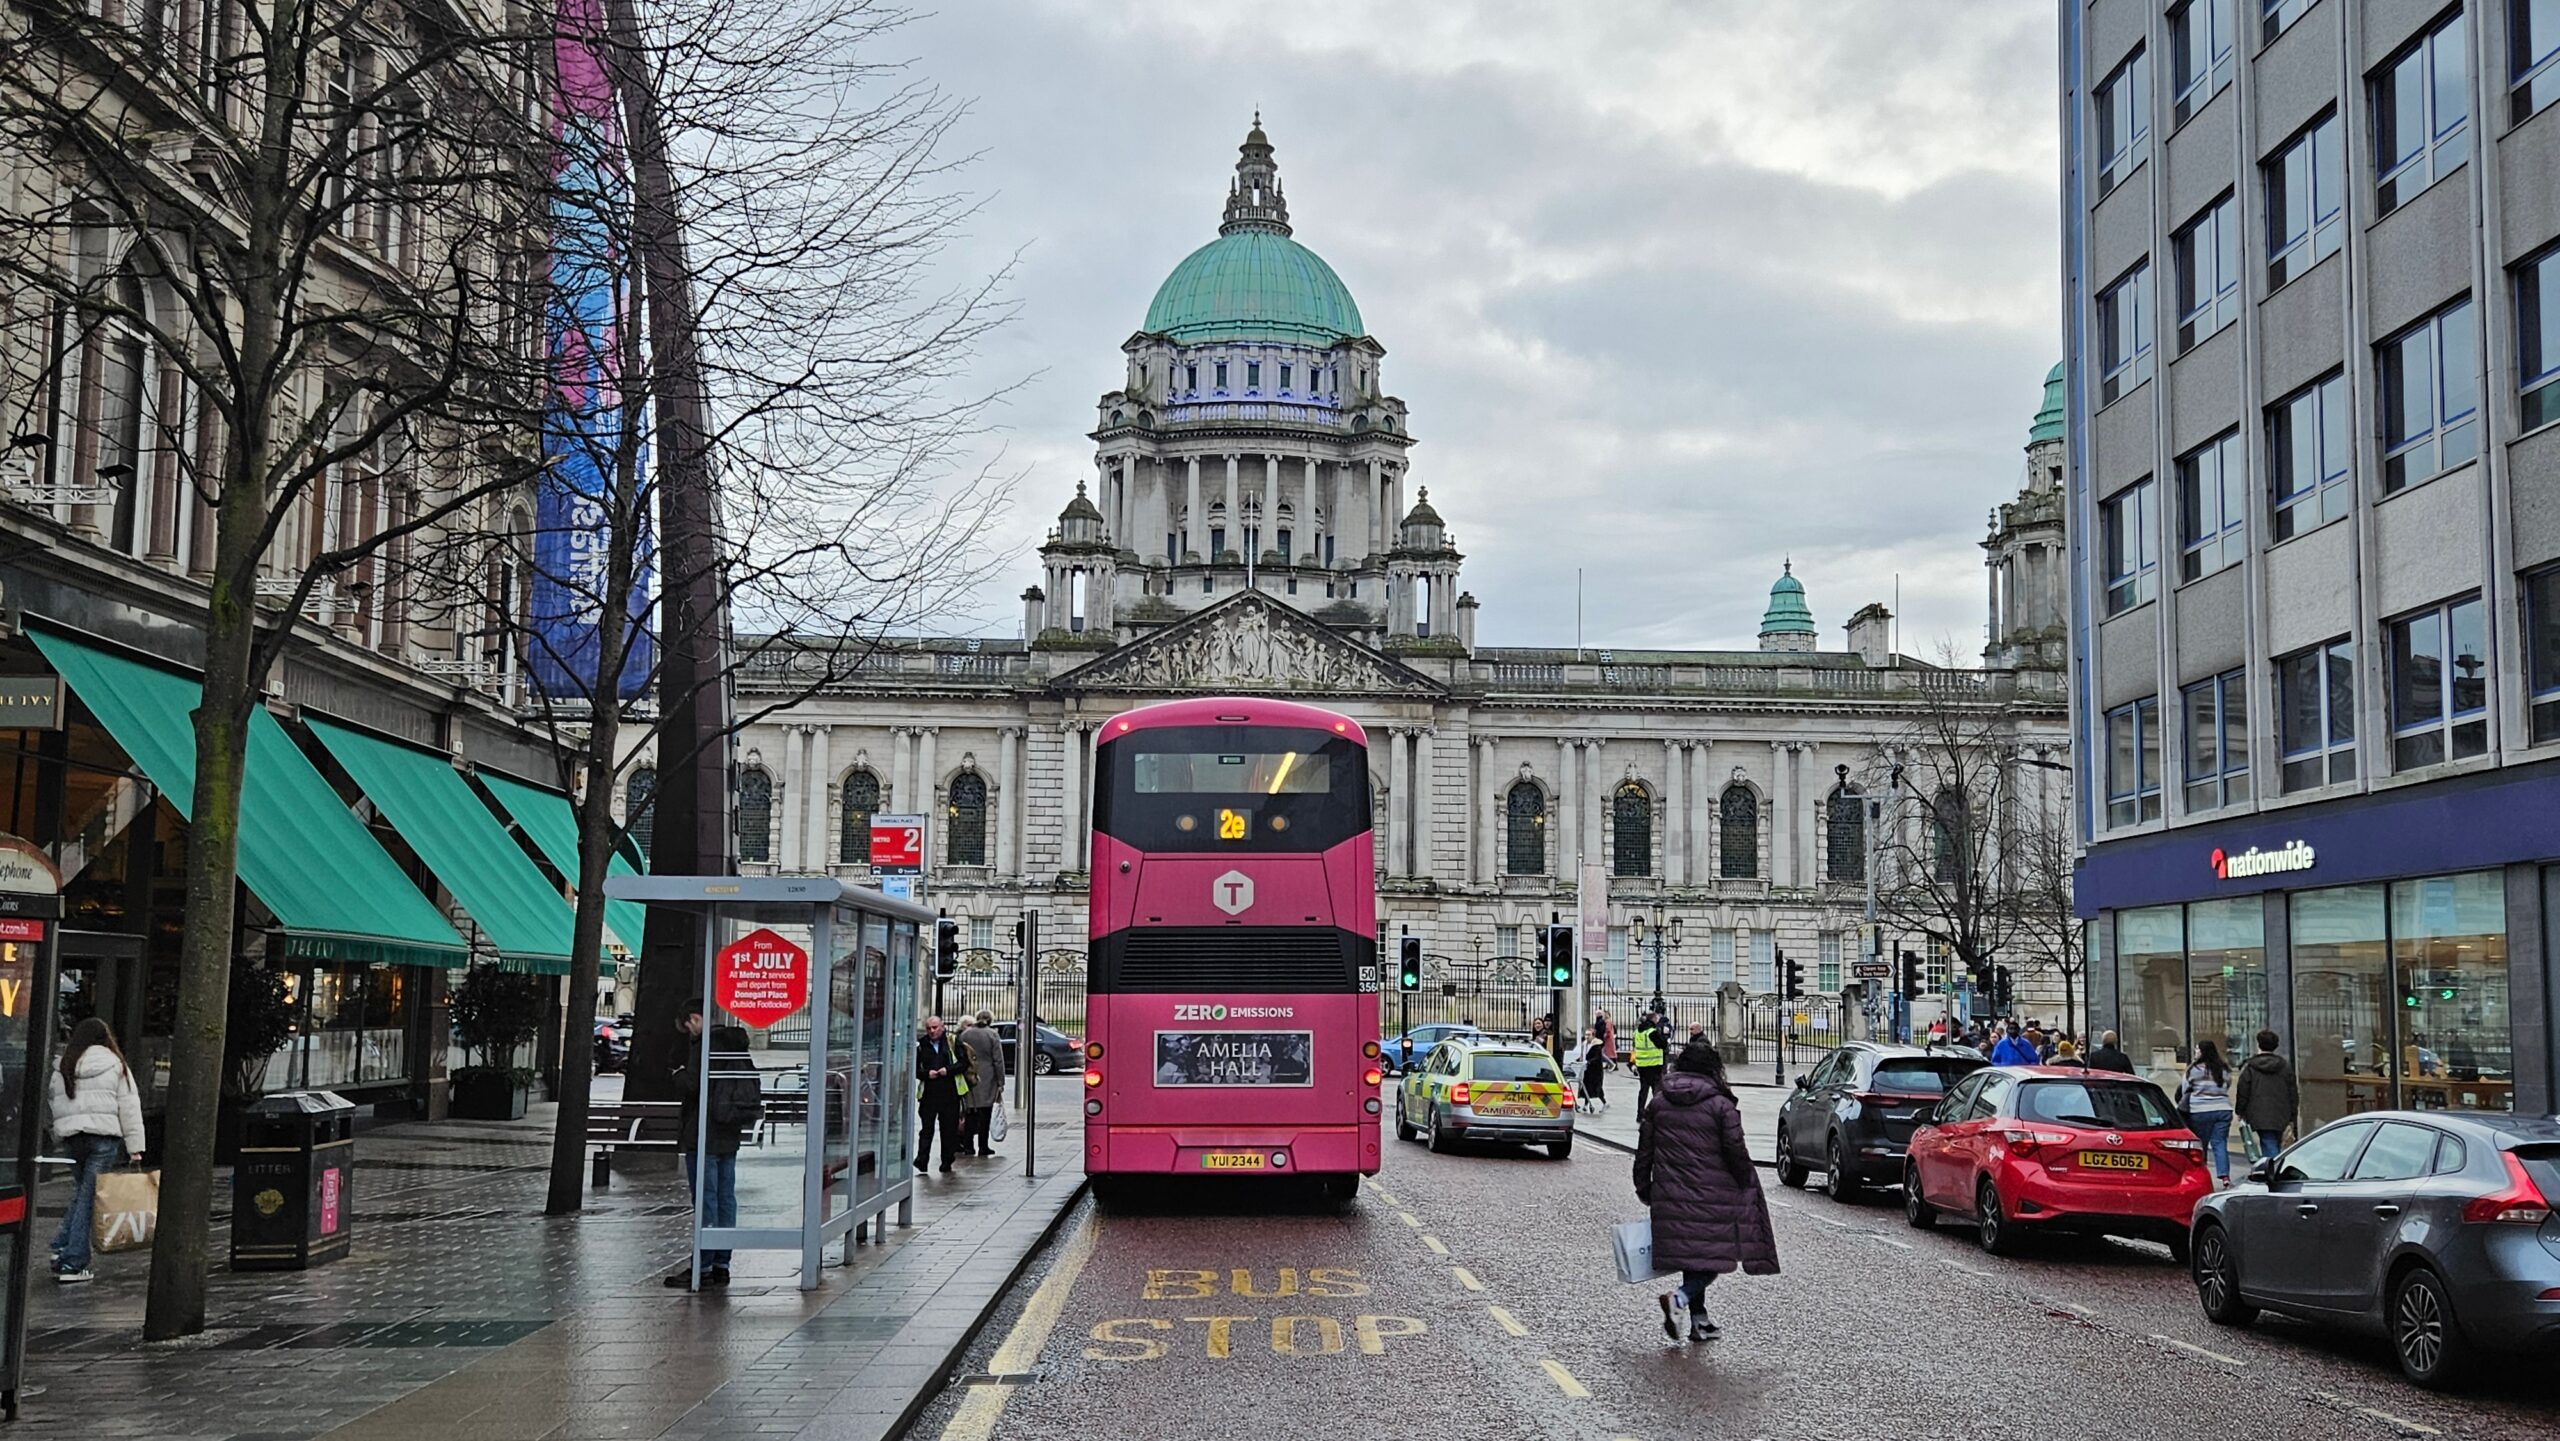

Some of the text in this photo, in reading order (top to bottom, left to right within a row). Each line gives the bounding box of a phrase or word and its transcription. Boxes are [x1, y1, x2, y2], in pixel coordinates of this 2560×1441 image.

[22, 695, 51, 706] IVY
[1220, 809, 1245, 839] 2e
[904, 828, 919, 851] 2
[2227, 840, 2315, 878] nationwide
[0, 861, 33, 882] ephone
[1224, 883, 1244, 906] T
[754, 941, 772, 950] From
[732, 952, 794, 969] 1st JULY
[739, 971, 760, 979] Metro
[762, 971, 768, 979] 2
[1361, 968, 1375, 980] 50
[749, 981, 770, 990] depart
[772, 981, 787, 989] from
[734, 991, 788, 1000] Donegall Place
[1174, 1004, 1294, 1021] ZERO EMISSIONS
[1196, 1042, 1272, 1058] AMELIA
[1210, 1061, 1263, 1077] HALL
[1482, 1106, 1548, 1116] AMBULANCE
[1211, 1155, 1260, 1167] YUI 2344
[2084, 1153, 2144, 1168] LGZ 6062
[248, 1164, 292, 1174] LITTER
[1142, 1267, 1371, 1300] BUS
[1083, 1314, 1429, 1362] STOP
